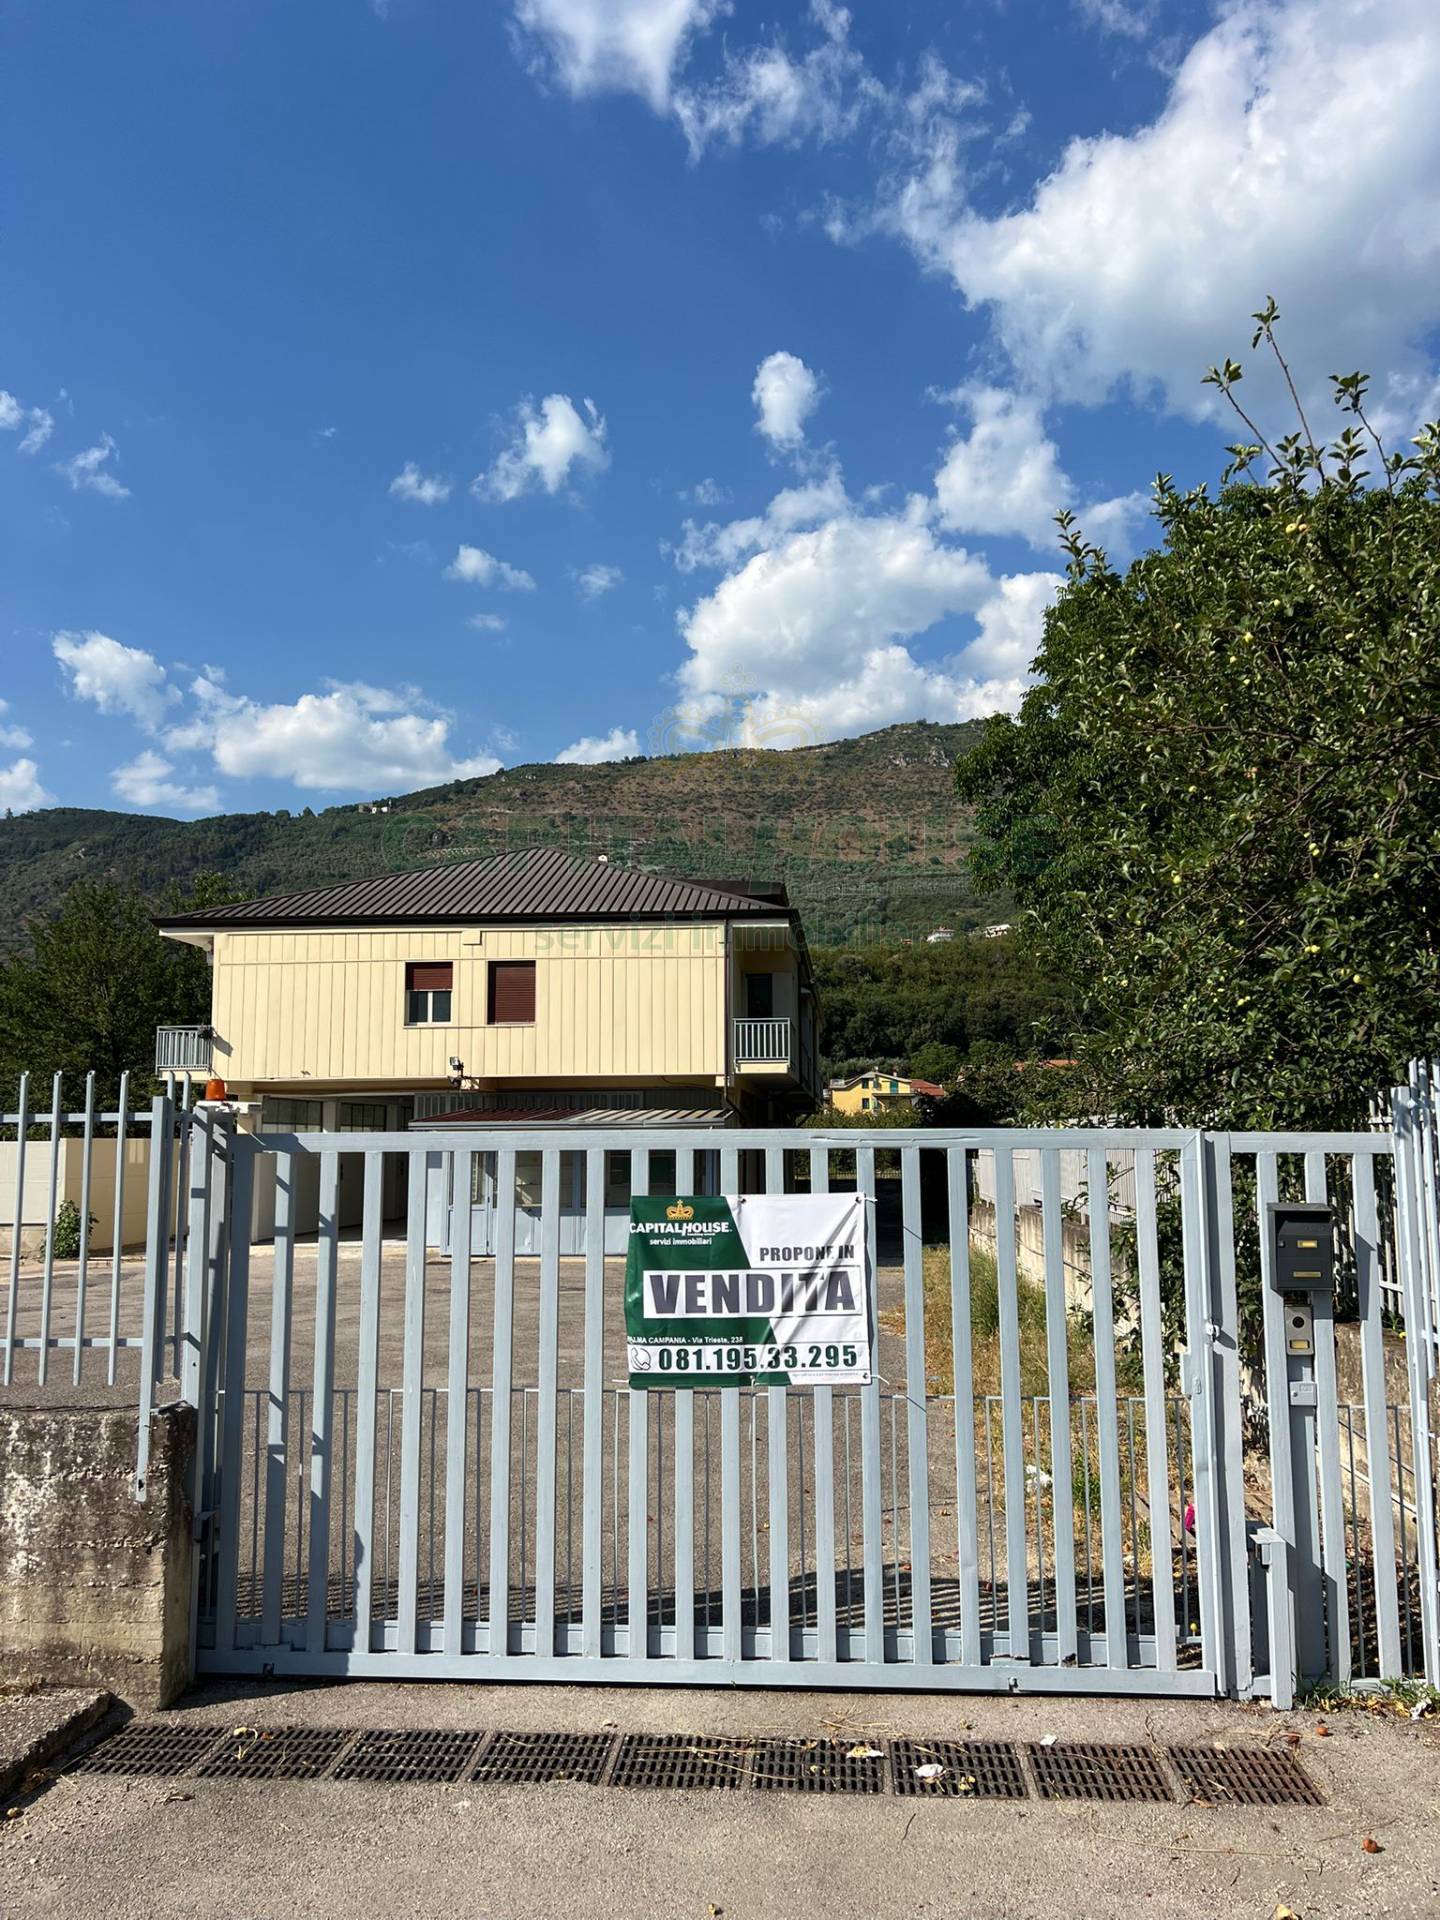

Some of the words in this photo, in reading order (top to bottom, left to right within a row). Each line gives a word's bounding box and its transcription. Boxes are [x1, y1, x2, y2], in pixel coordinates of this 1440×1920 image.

[649, 1237, 671, 1245] servizi
[673, 1237, 712, 1246] immobiliari
[838, 1244, 855, 1259] IN
[650, 1272, 856, 1313] VENDITA
[648, 1336, 687, 1344] CAMPANIA
[692, 1336, 703, 1344] Via
[659, 1346, 857, 1370] 081.195.33.295
